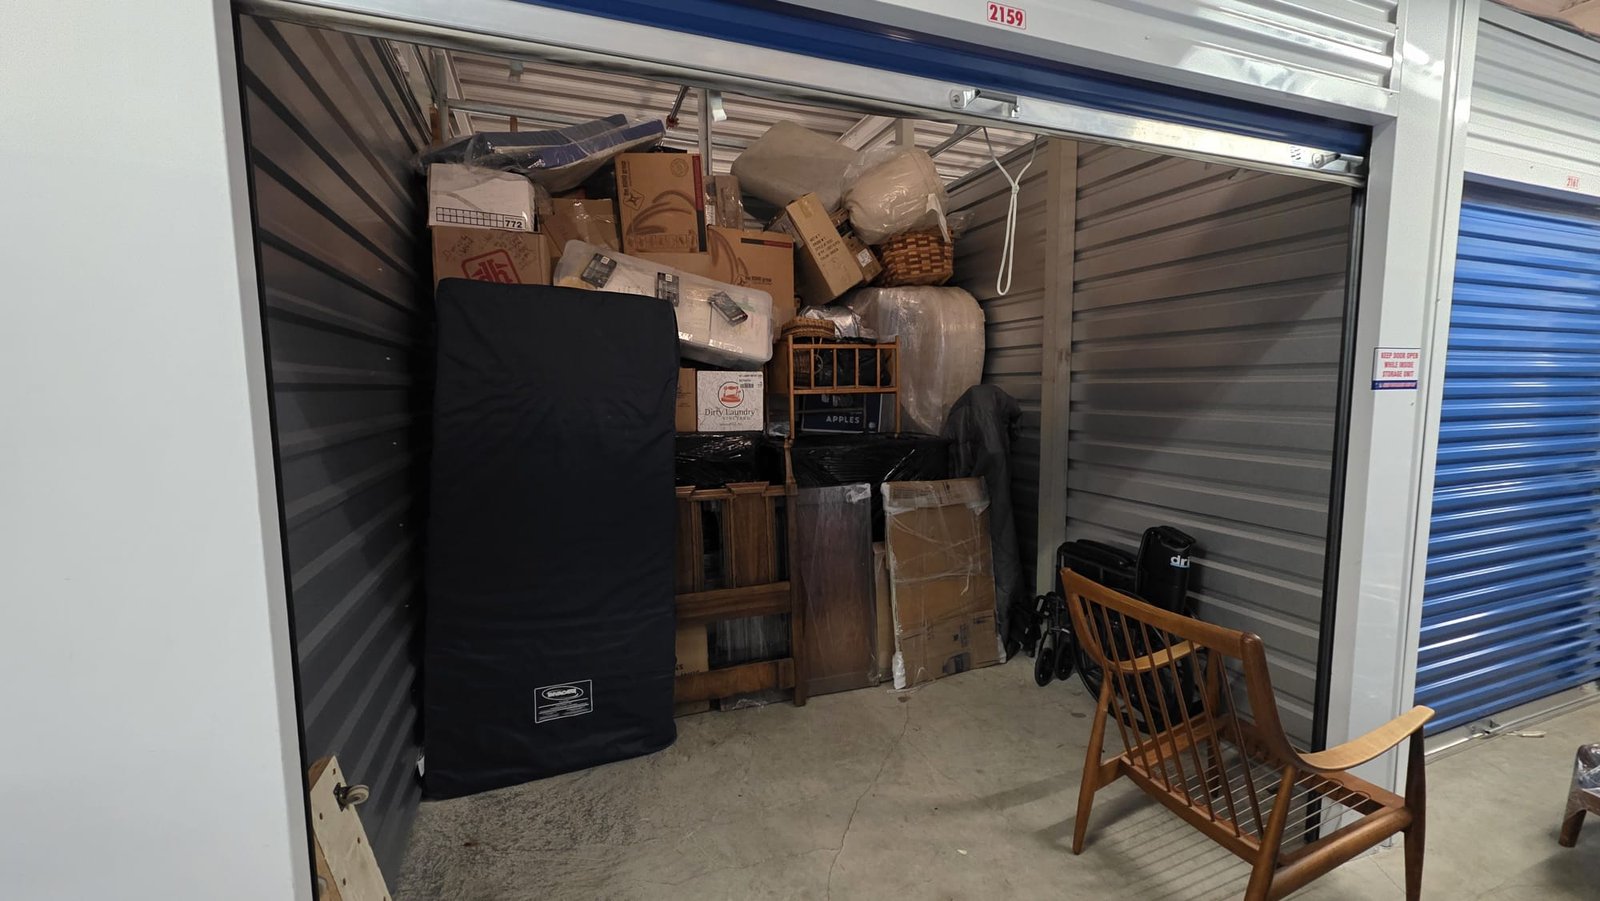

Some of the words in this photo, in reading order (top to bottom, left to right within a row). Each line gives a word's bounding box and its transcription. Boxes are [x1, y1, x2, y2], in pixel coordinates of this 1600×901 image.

[990, 4, 1023, 26] 2159
[505, 219, 523, 228] 772
[704, 407, 723, 417] Dirty
[725, 408, 755, 416] Laundry
[826, 415, 860, 424] APPLES
